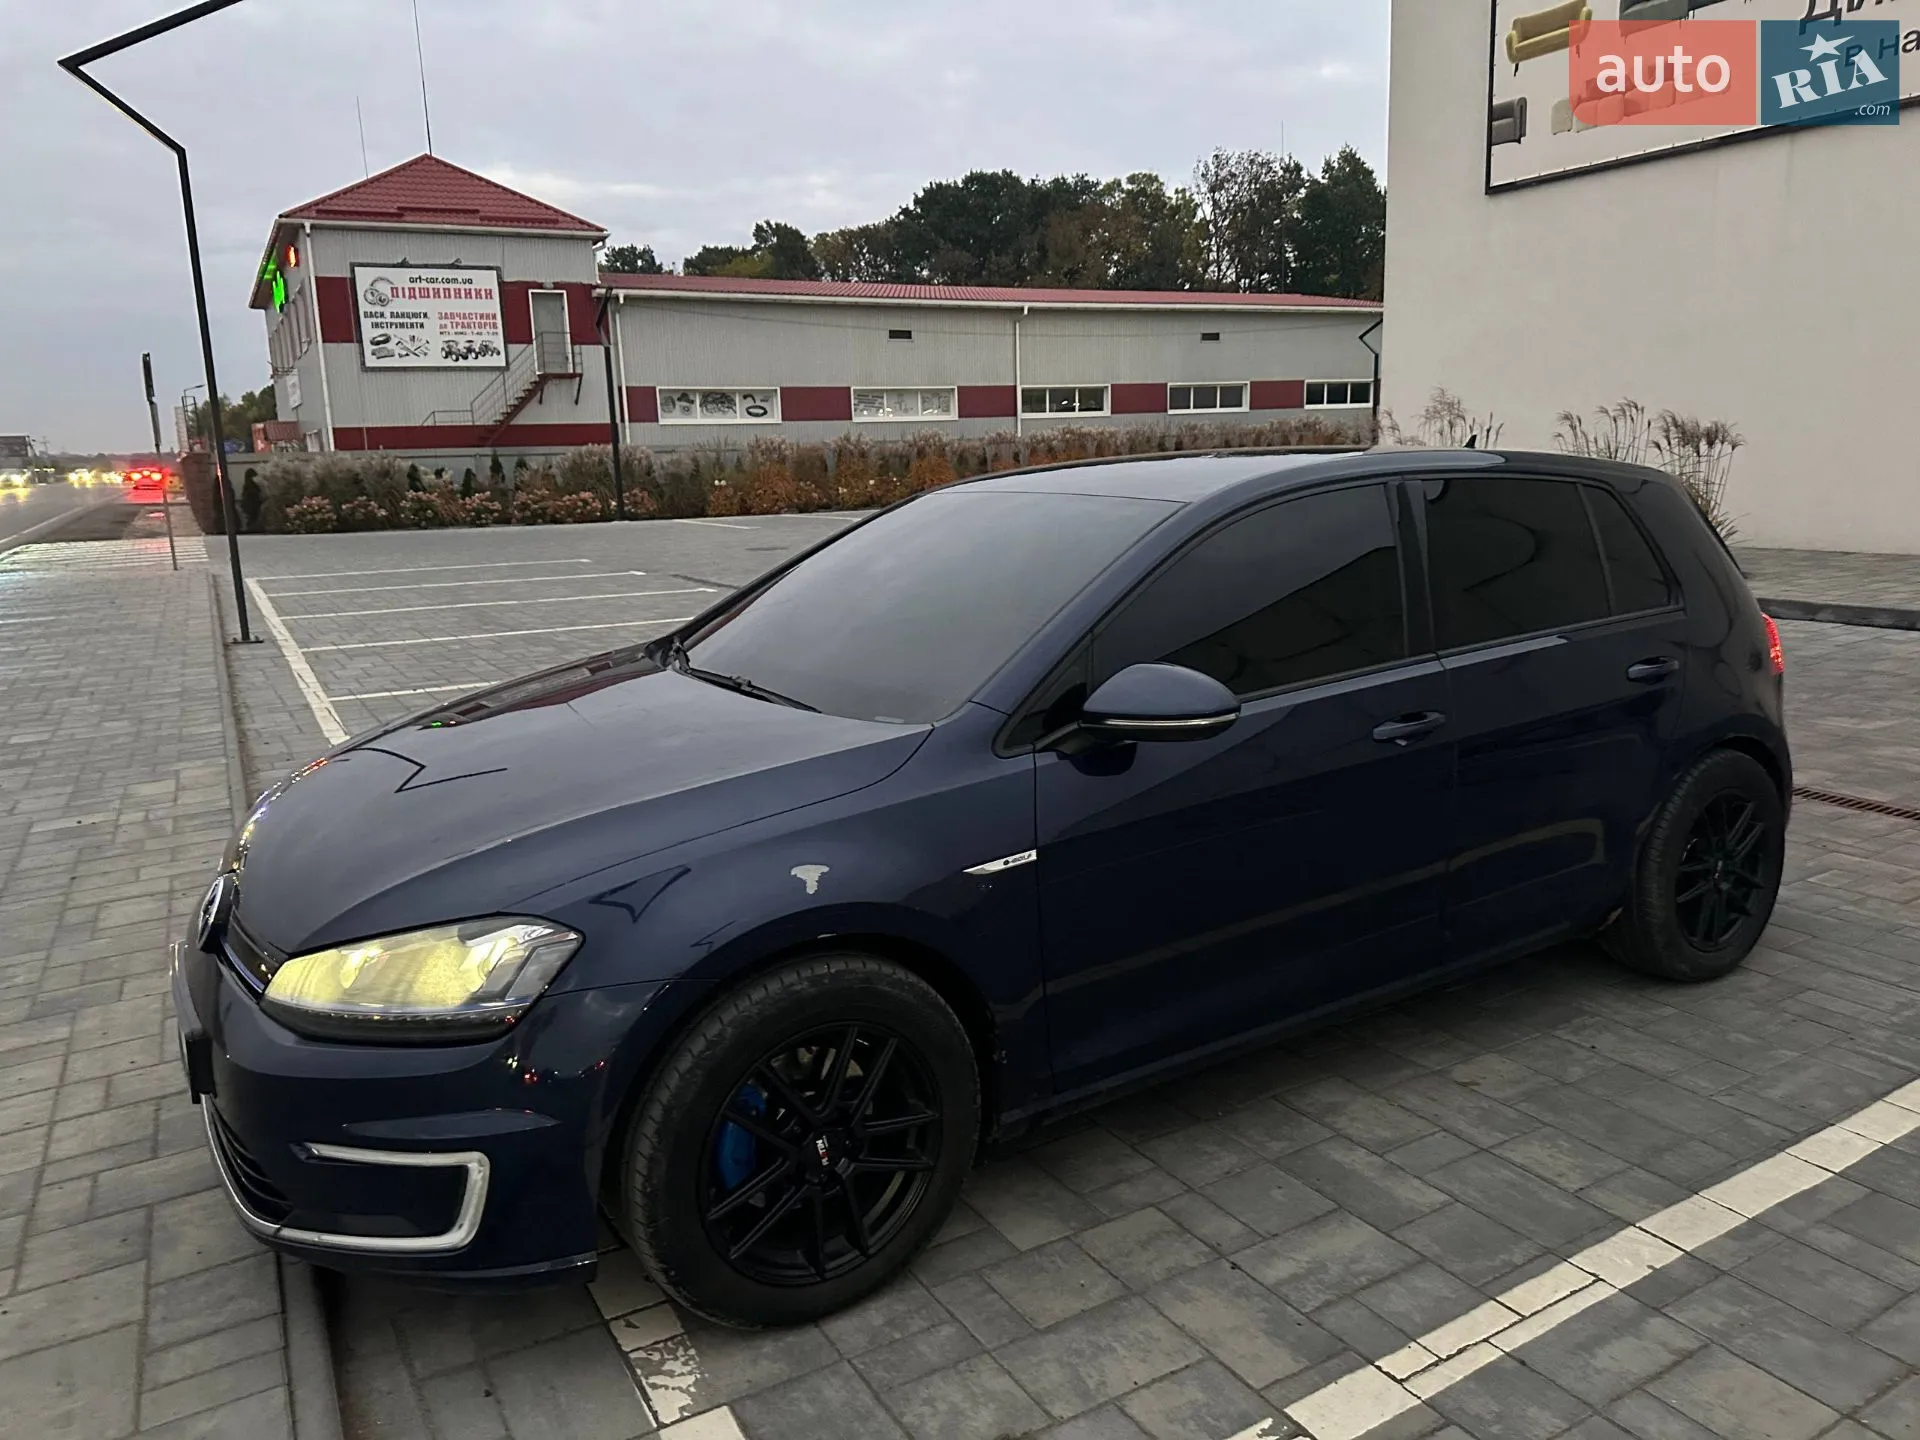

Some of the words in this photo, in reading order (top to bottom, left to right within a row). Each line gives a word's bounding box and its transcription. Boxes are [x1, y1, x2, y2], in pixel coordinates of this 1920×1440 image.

[409, 275, 473, 285] art-car.com.ua
[390, 286, 494, 300] ПІДШИПНИКИ
[437, 311, 497, 321] ЗАПЧАСТИНИ
[370, 321, 425, 329] ІНСТРУМЕНТИ
[449, 321, 498, 330] ТРАКТОРІВ
